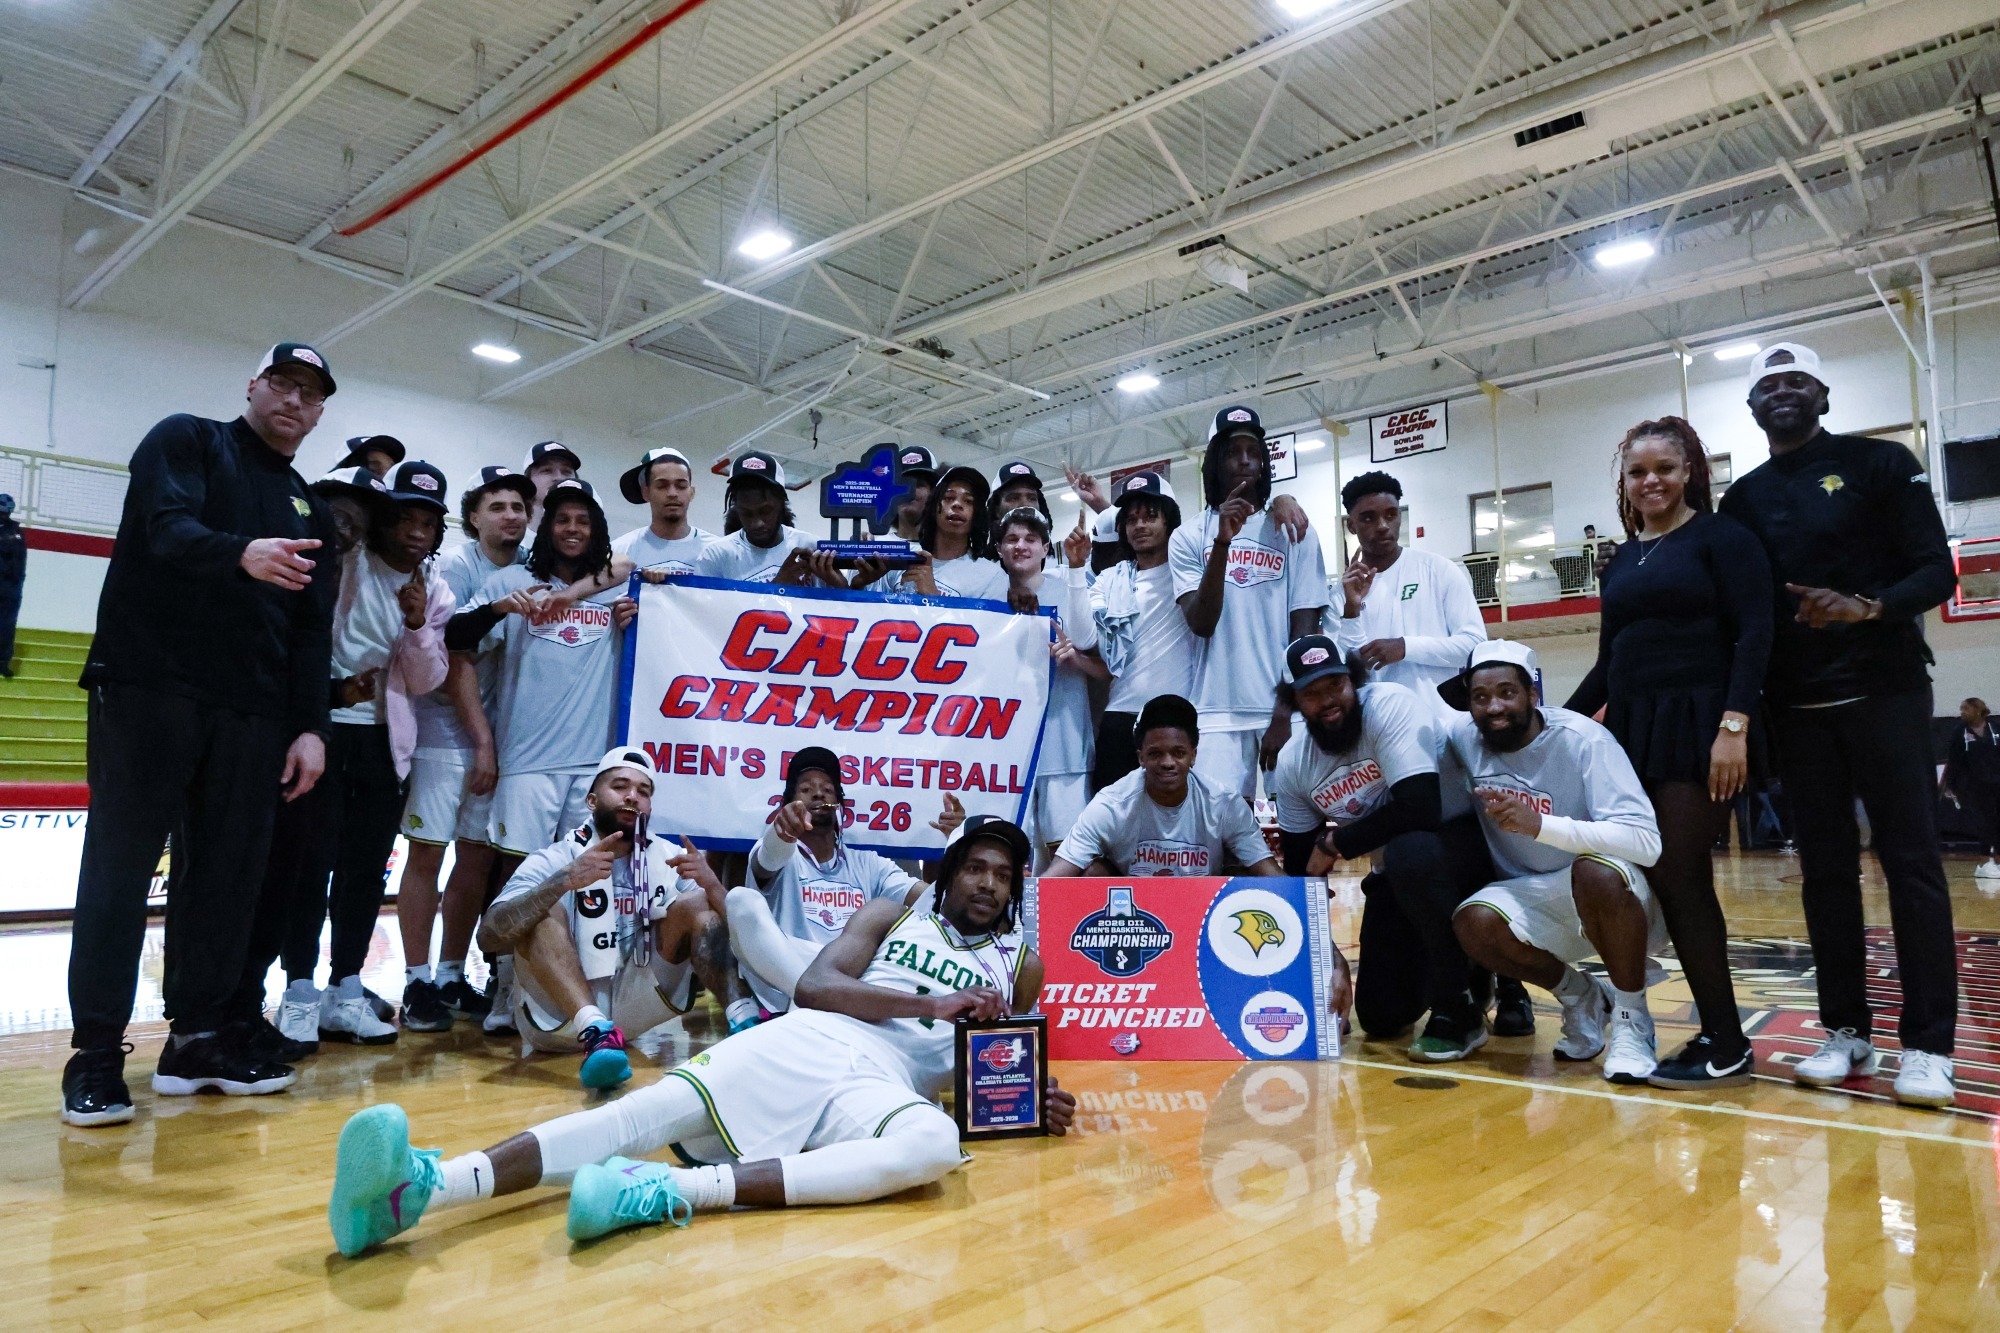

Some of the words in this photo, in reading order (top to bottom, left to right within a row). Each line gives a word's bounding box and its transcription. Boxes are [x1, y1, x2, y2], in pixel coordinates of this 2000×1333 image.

[1380, 419, 1438, 439] CHAMPION
[1387, 409, 1430, 428] CACC
[1393, 434, 1424, 446] BOWLING
[1205, 549, 1284, 572] AMPIONS
[544, 609, 610, 627] AMPIONS
[719, 609, 980, 685] CACC
[659, 674, 1022, 741] CHAMPION
[642, 741, 766, 780] MEN'S
[780, 750, 1026, 794] SKETBALL
[0, 814, 88, 829] SITIV
[765, 794, 912, 832] 25-26
[1026, 884, 1035, 894] 26
[1306, 882, 1317, 914] QUALIFIER
[1025, 896, 1035, 917] SEAT:
[1086, 926, 1110, 934] MEN'S
[1110, 926, 1157, 934] BASKETBALL
[1308, 915, 1320, 952] AUTOMATIC
[1073, 934, 1170, 948] CHAMPIONSHIP
[1311, 954, 1323, 997] TOURNAMENT
[1043, 983, 1157, 1004] TICKET
[1056, 1007, 1206, 1029] PUNCHED
[1315, 1006, 1326, 1036] DIVISION
[978, 1048, 1015, 1062] CACC
[1318, 1037, 1328, 1056] NCAA
